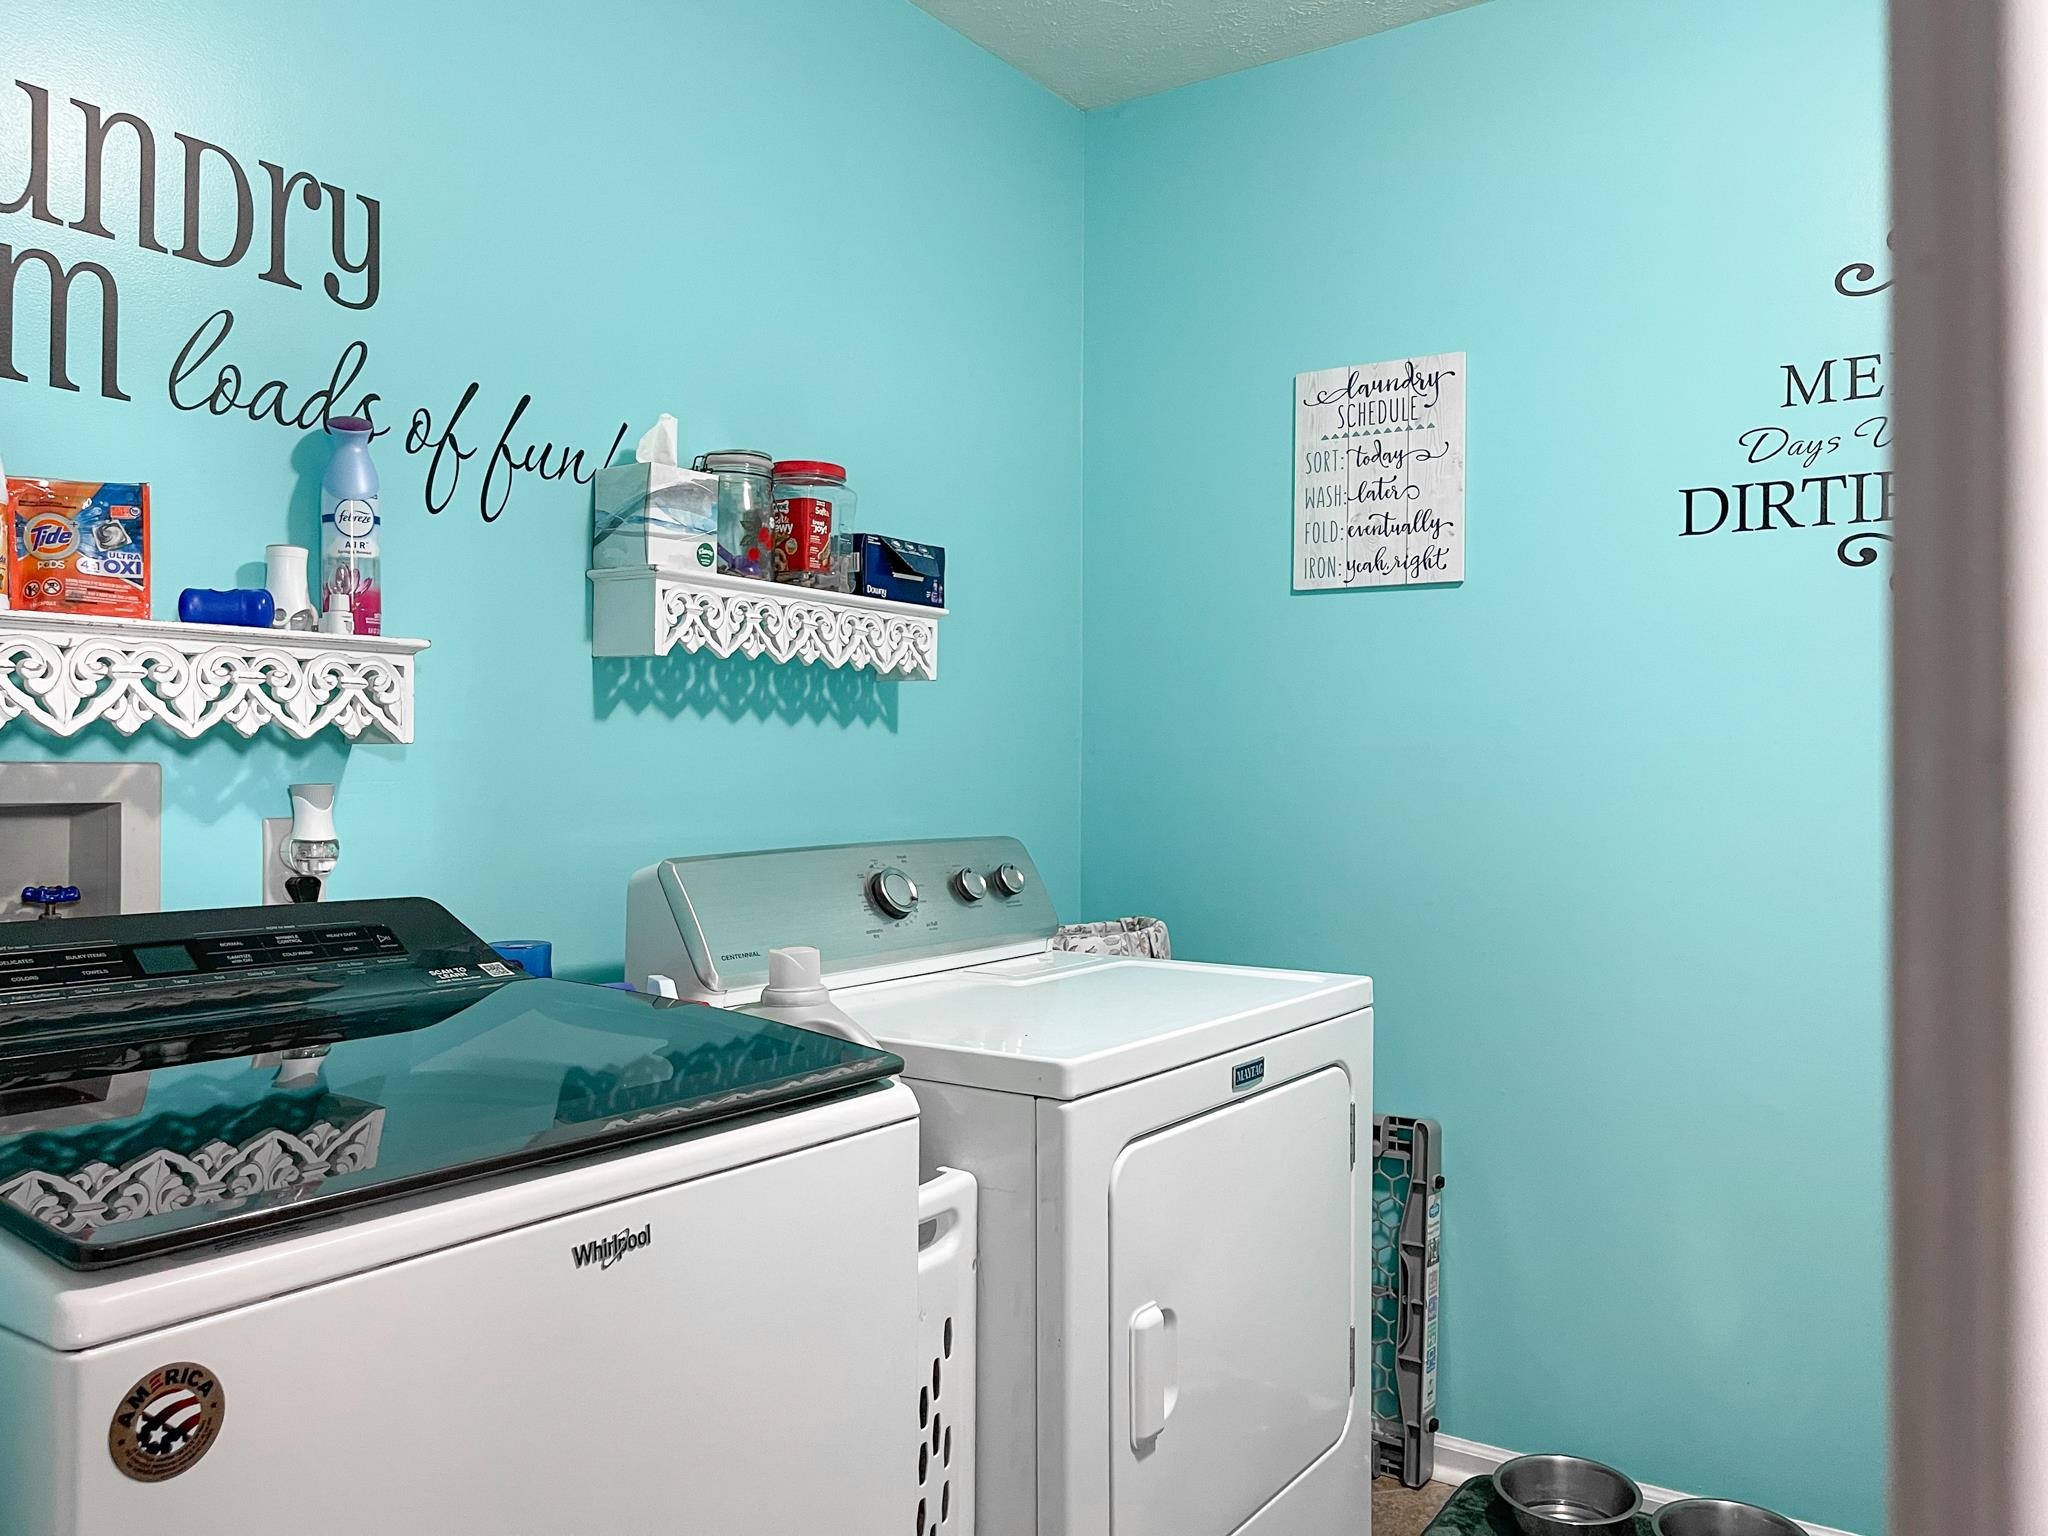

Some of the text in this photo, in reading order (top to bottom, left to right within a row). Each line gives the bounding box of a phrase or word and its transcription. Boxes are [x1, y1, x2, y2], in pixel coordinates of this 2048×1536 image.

[1303, 361, 1456, 409] laundry
[1780, 353, 1893, 408] ME
[167, 309, 391, 443] loads
[404, 382, 478, 514] of
[1337, 395, 1419, 429] SCHEDULE
[1305, 439, 1450, 475] SORT: today
[1738, 427, 1841, 468] Days
[1305, 475, 1421, 509] WASH: later
[31, 525, 72, 551] Tide
[1305, 508, 1454, 545] FOLD: eventually
[109, 552, 141, 561] ULTRA
[345, 541, 365, 549] AIR
[1304, 556, 1342, 580] IRON:
[1382, 544, 1450, 579] right
[103, 560, 142, 575] OXI
[866, 584, 887, 598] Downy
[428, 968, 453, 976] SCAN
[721, 951, 761, 962] CENTENNIAL
[1236, 1063, 1264, 1083] MAYTAG
[571, 1223, 652, 1270] Whirlpool
[117, 1367, 214, 1429] AMERICA
